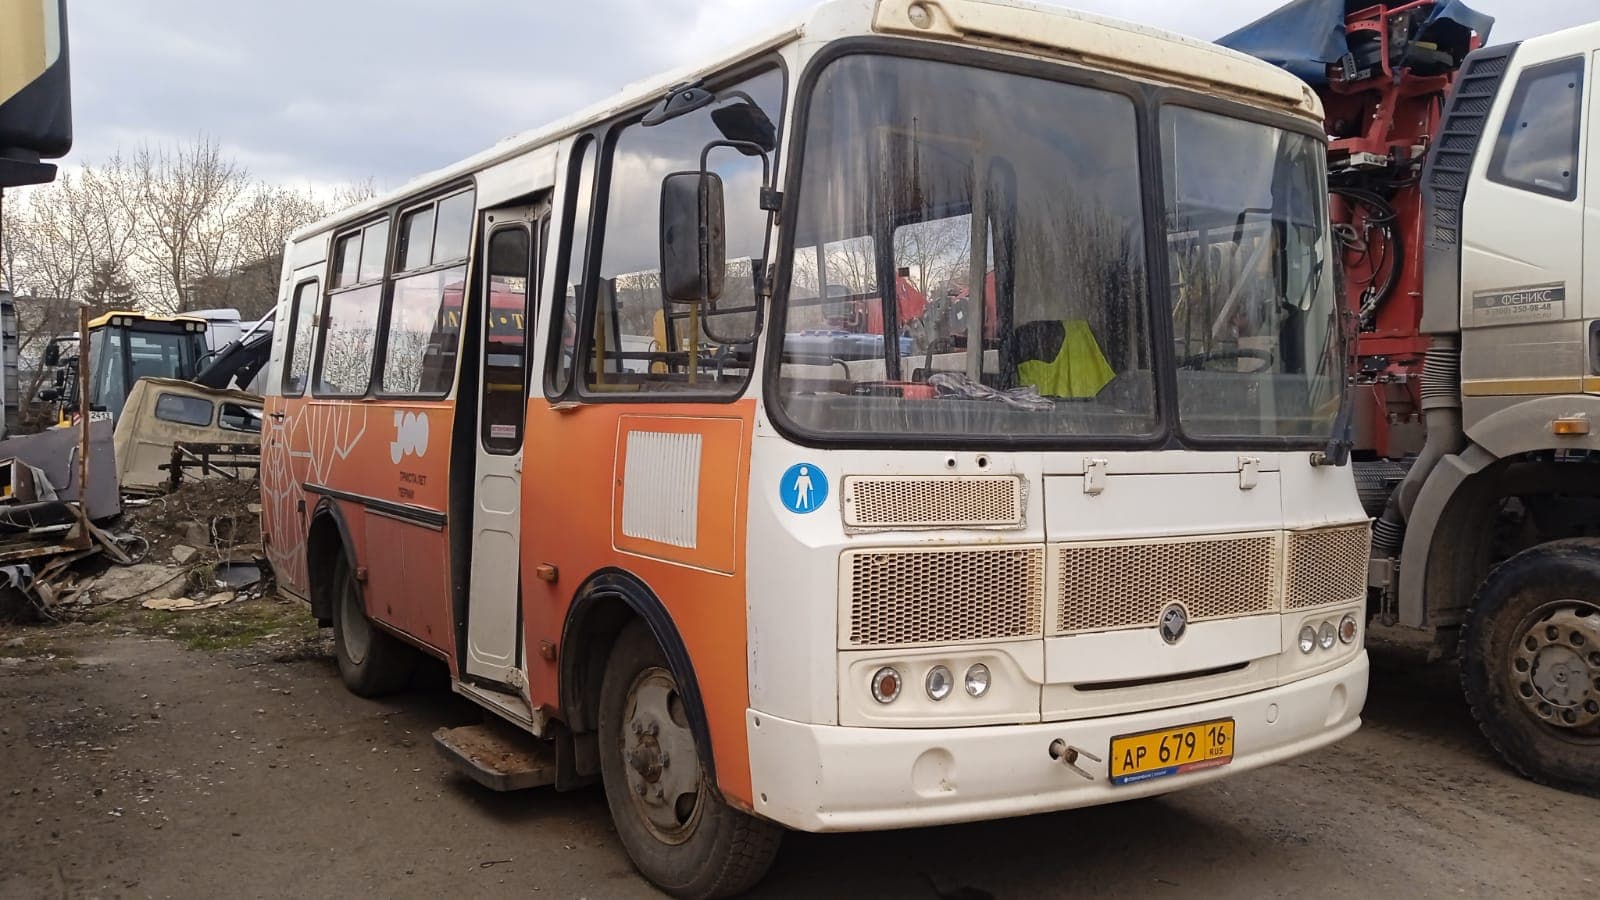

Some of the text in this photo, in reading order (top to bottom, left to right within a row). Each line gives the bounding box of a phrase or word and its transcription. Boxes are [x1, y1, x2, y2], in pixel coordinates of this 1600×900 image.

[1501, 290, 1552, 305] ФЕНИКС
[1123, 726, 1226, 771] АР 679 16
[1209, 746, 1224, 755] RUS
